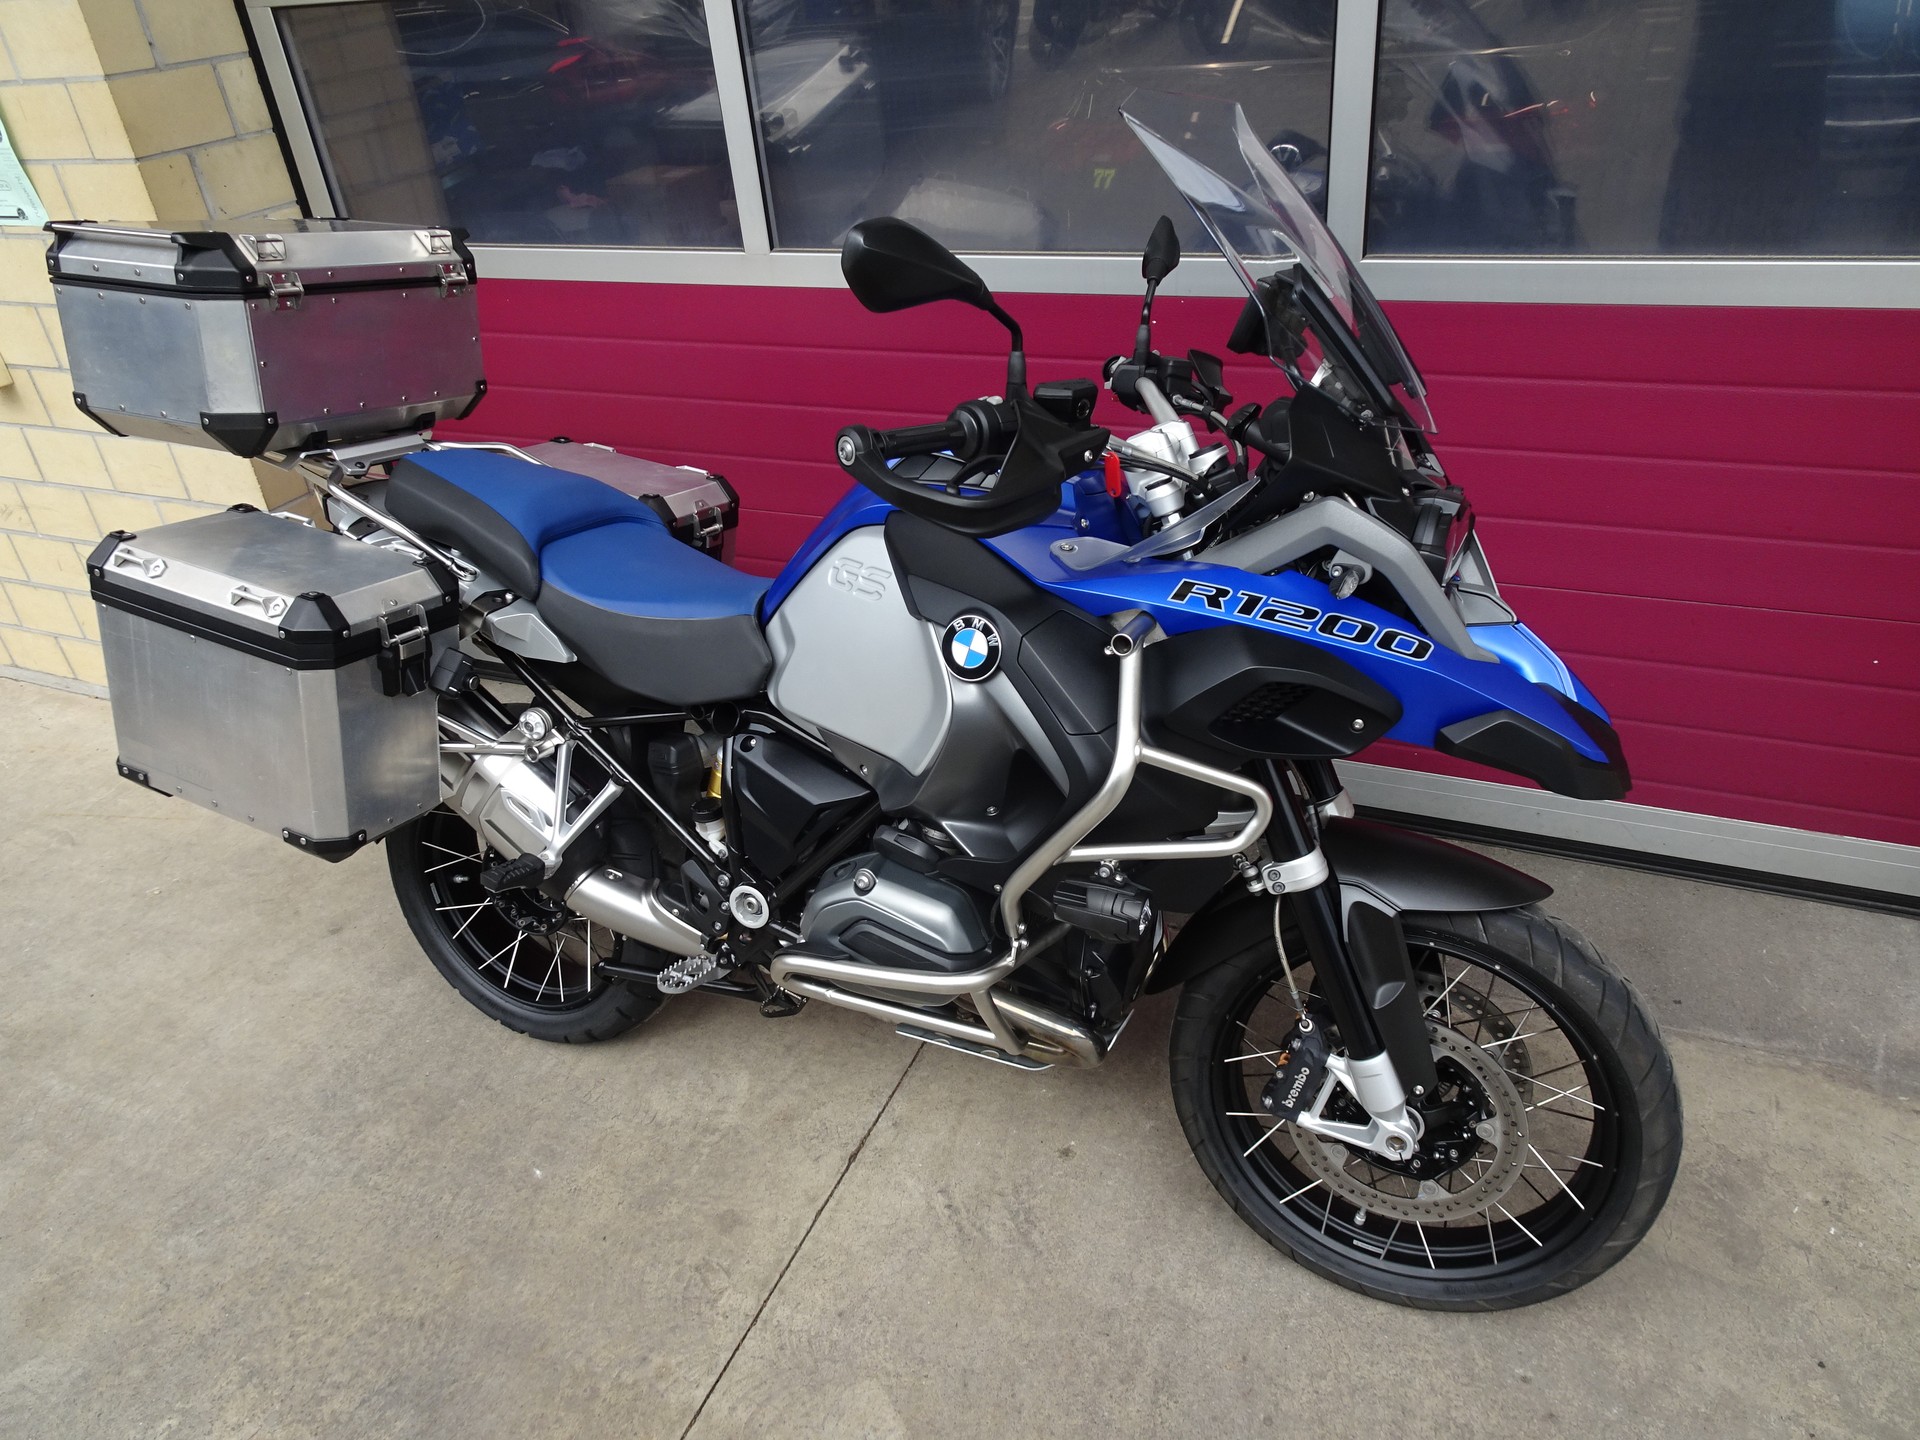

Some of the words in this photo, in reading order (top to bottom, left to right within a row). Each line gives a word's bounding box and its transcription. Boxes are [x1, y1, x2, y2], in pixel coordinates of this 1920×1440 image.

[1094, 168, 1116, 189] 77
[828, 557, 892, 601] GS
[953, 618, 999, 647] BMW
[1167, 578, 1435, 661] R1200
[1281, 1067, 1310, 1109] brembo
